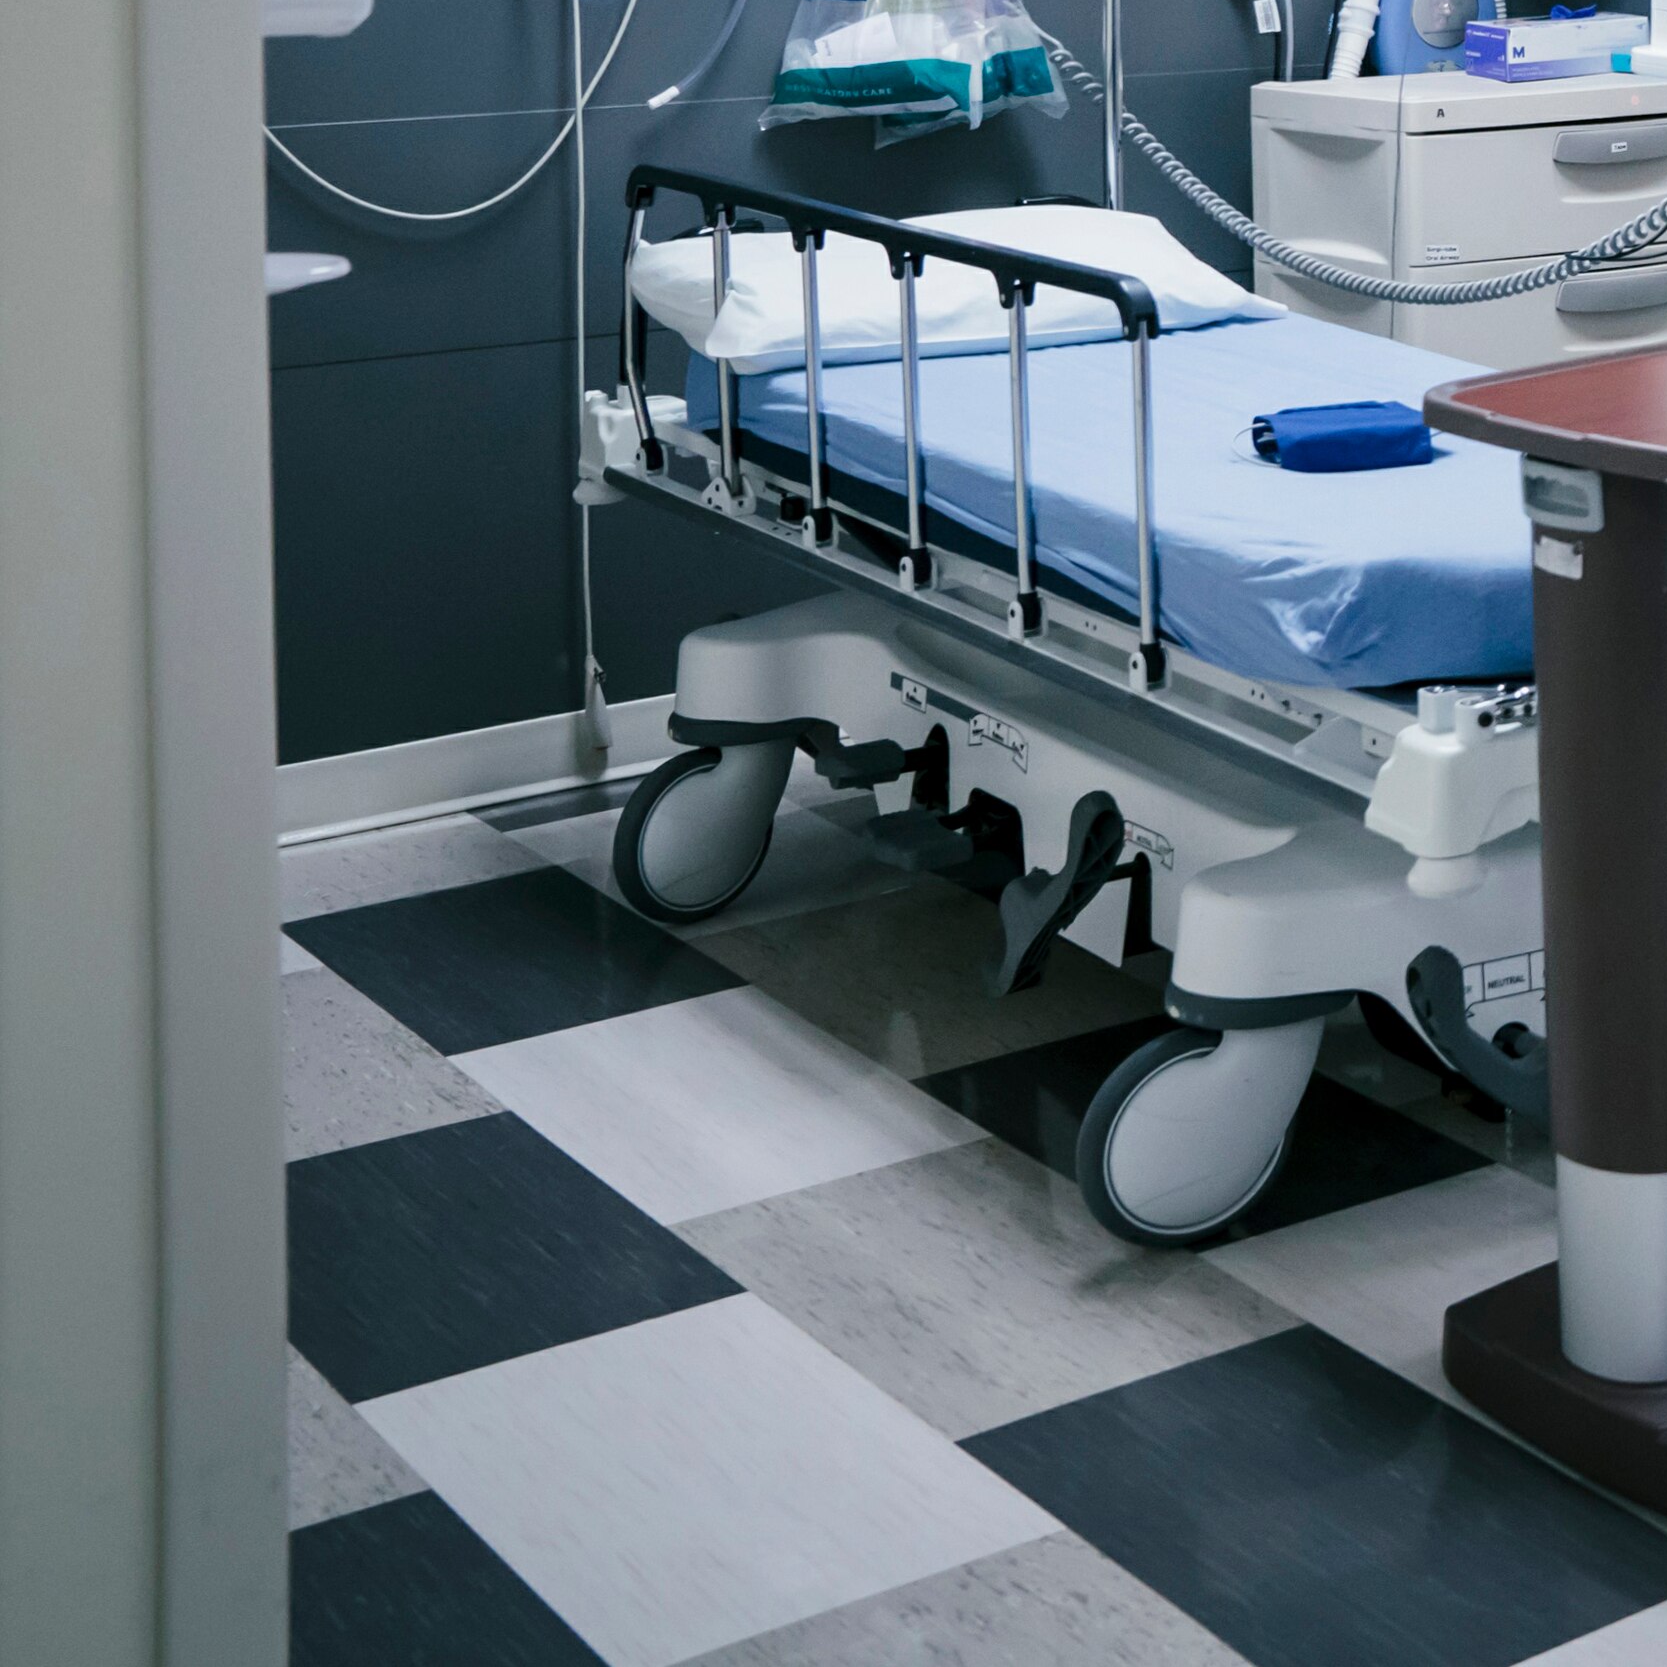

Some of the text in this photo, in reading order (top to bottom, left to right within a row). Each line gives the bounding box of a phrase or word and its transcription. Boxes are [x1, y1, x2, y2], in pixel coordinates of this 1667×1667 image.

[1512, 46, 1525, 59] M
[862, 87, 893, 97] CARE
[1436, 108, 1445, 118] A
[1487, 975, 1526, 989] NEUTRAL
